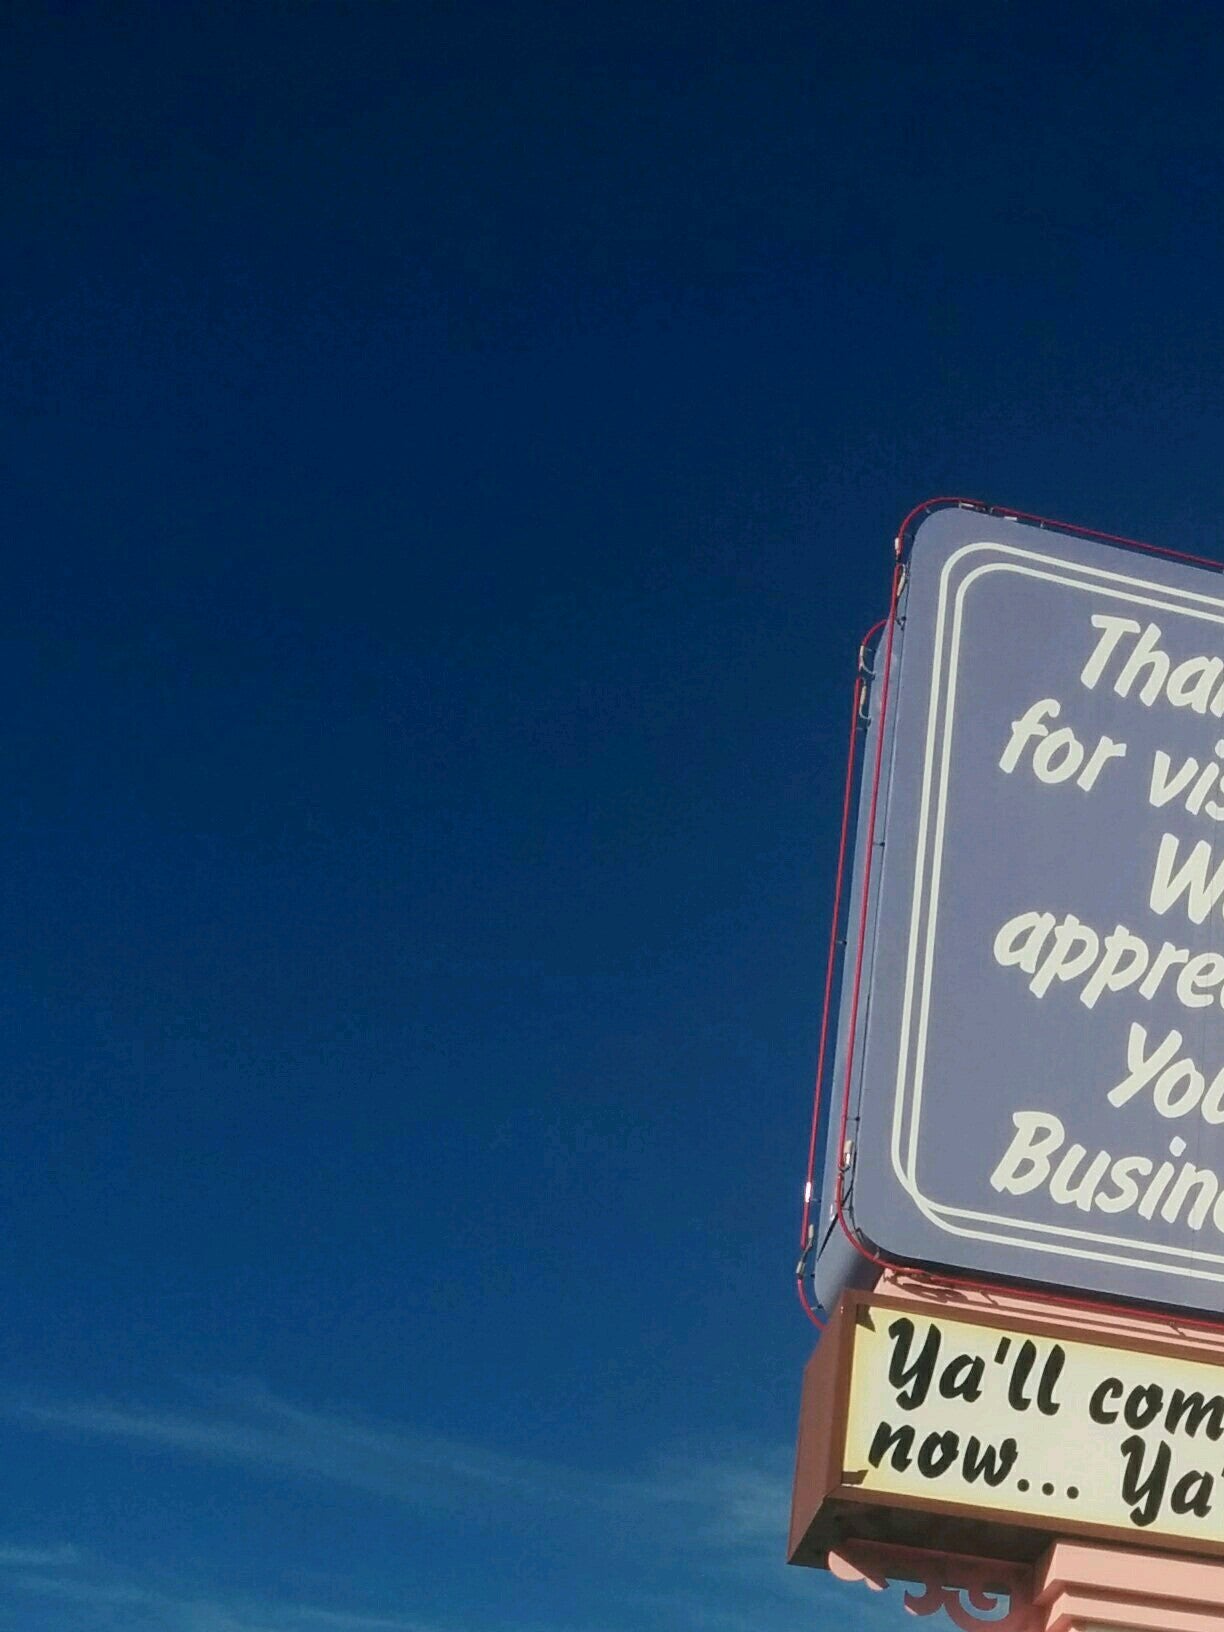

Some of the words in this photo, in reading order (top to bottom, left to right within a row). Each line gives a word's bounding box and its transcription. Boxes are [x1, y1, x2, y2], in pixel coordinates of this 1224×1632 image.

[999, 699, 1126, 792] for
[887, 1317, 1065, 1415] Ya'll
[867, 1420, 1080, 1499] now...
